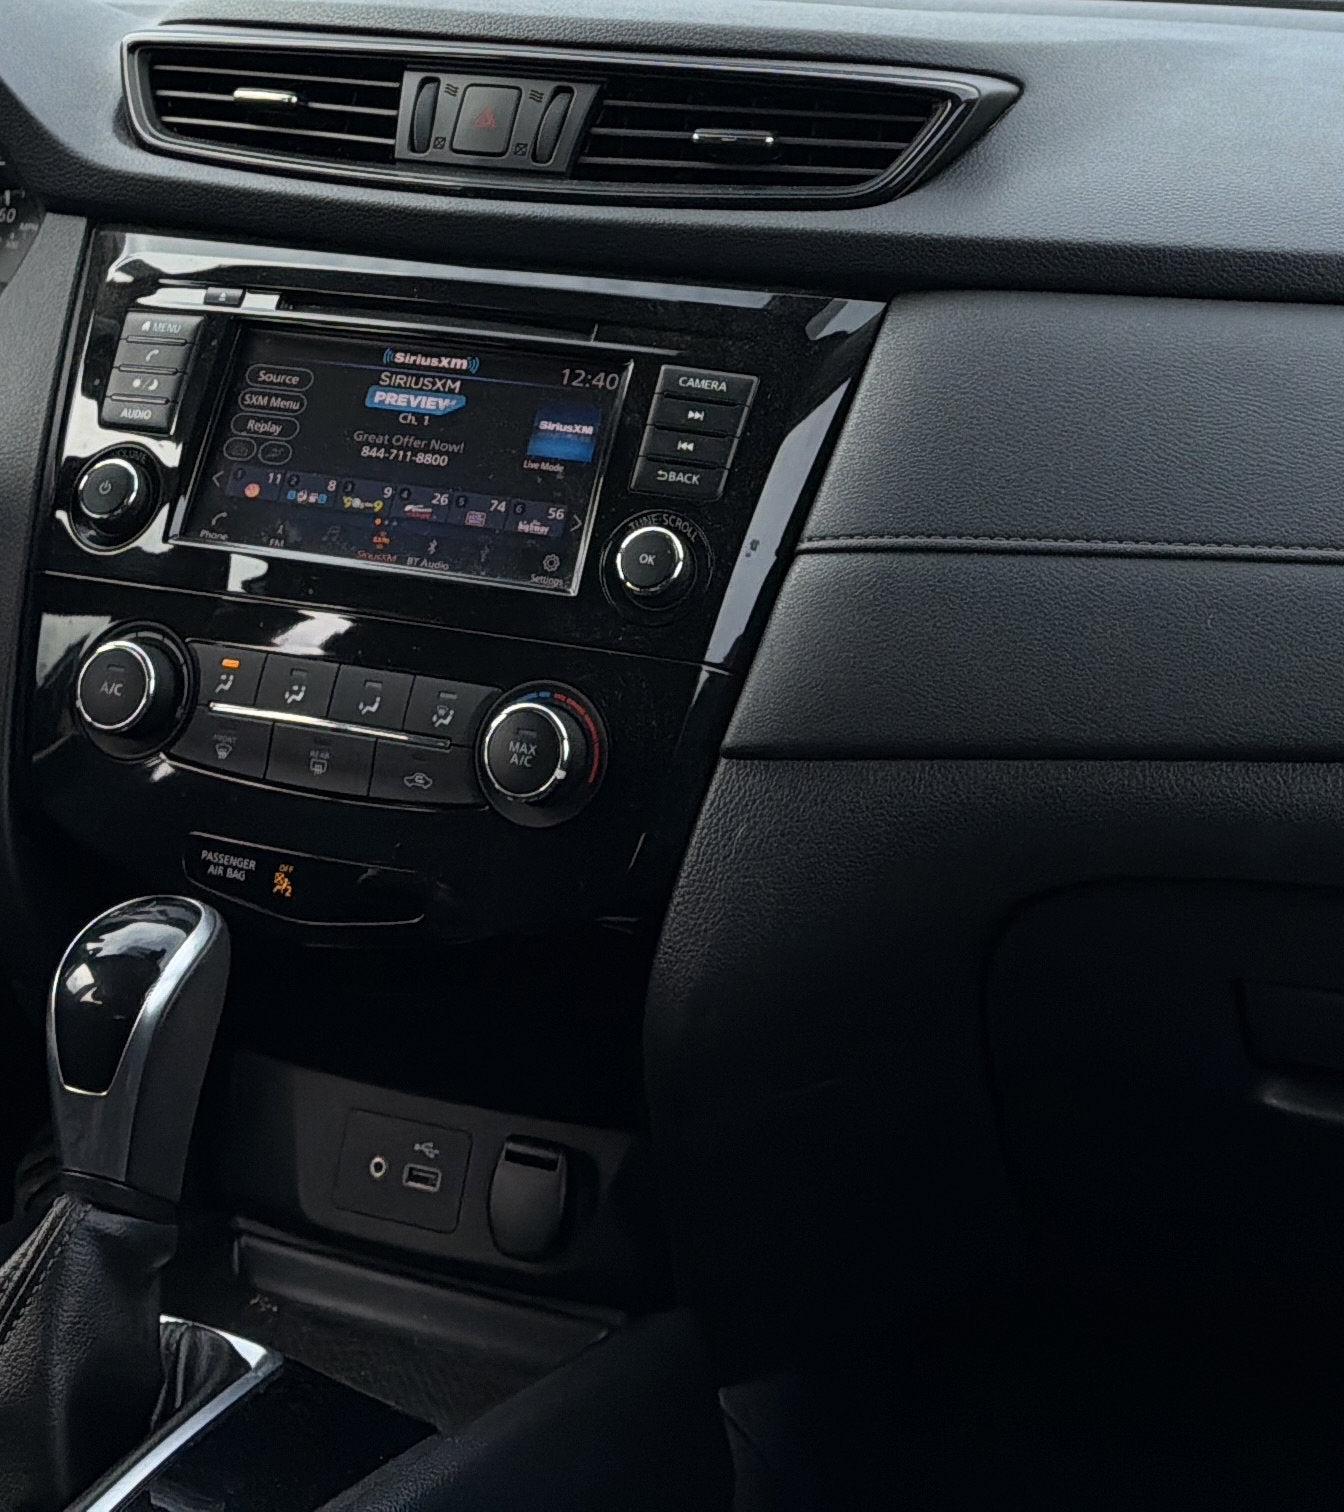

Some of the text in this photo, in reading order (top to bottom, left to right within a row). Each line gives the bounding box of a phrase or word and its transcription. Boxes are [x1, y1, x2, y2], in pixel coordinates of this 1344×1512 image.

[152, 321, 182, 334] MENU
[257, 369, 301, 386] Source
[378, 371, 463, 394] SIRIUSXM
[561, 368, 620, 391] 12:40
[678, 376, 728, 393] CAMERA
[243, 392, 301, 410] SXM Menu
[373, 390, 457, 411] PREVIEW
[119, 406, 153, 421] AUDIO
[423, 415, 431, 427] 1
[246, 419, 284, 436] Replay
[353, 430, 466, 455] Great Offer Now!
[360, 445, 450, 467] 844-711-8800
[523, 459, 565, 473] Live Mode
[268, 472, 282, 485] 11
[327, 479, 338, 492] 8
[668, 470, 701, 486] BACK
[382, 487, 393, 499] 9
[431, 492, 450, 506] 26
[489, 499, 507, 514] 74
[546, 506, 565, 520] 56
[268, 538, 285, 548] FM
[420, 557, 450, 571] Audio
[638, 553, 656, 566] OK
[529, 573, 564, 588] Settings
[99, 680, 124, 697] A/C
[508, 740, 538, 756] MAX
[509, 755, 533, 768] A/C
[200, 849, 257, 871] PASSENGER
[207, 863, 246, 882] AIR BAG
[278, 863, 295, 873] OFF
